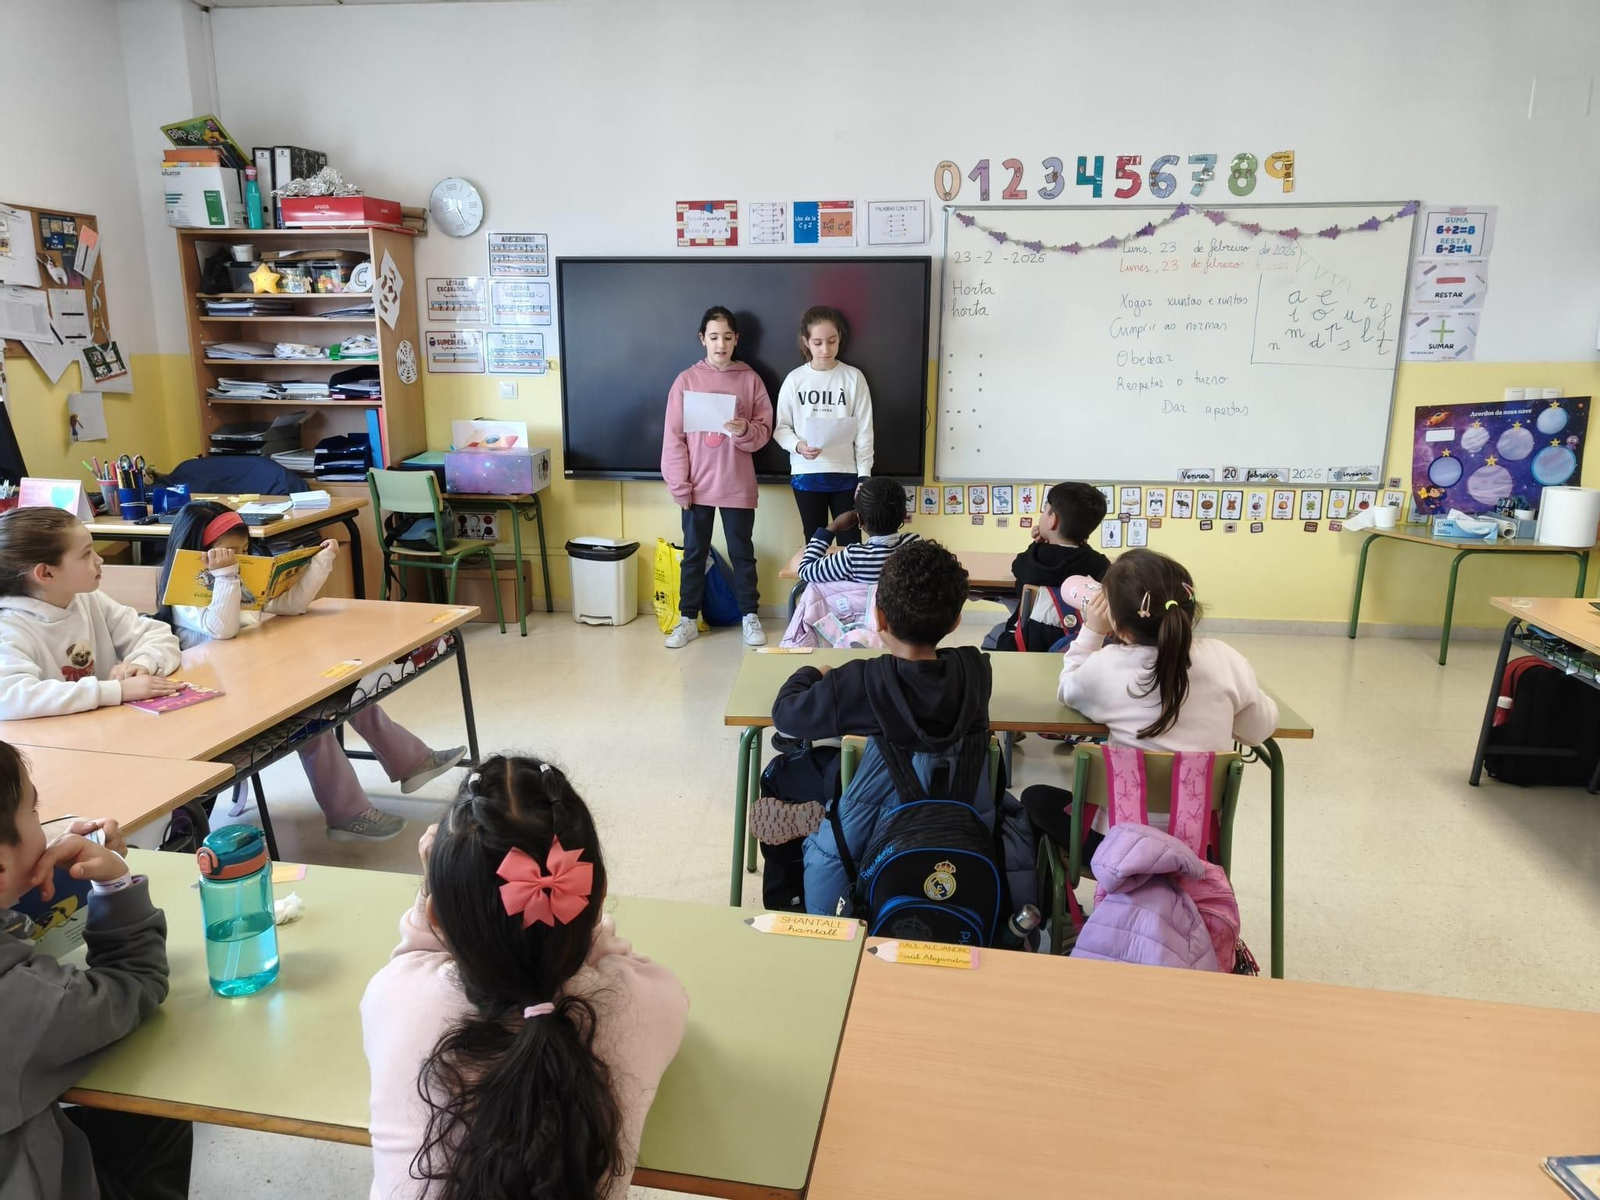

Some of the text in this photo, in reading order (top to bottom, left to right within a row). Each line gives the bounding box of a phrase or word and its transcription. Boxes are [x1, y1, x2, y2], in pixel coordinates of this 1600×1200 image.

[934, 150, 1295, 201] 0 1 2 3 4 5 6 7 8 9
[1436, 225, 1475, 235] 6+2=8
[1160, 242, 1177, 253] 23
[1194, 240, 1204, 253] de
[1435, 245, 1472, 253] 6-2=4
[1191, 259, 1201, 268] de
[952, 279, 995, 295] Horta
[1288, 289, 1338, 305] a e
[951, 297, 989, 317] horta
[1120, 293, 1152, 317] Xogar
[1311, 308, 1334, 321] o
[1344, 310, 1361, 323] u
[1110, 317, 1157, 339] Cumprir
[1186, 322, 1228, 331] normas
[1285, 328, 1305, 339] m
[1268, 342, 1280, 350] n
[1309, 333, 1325, 348] d
[1377, 330, 1393, 355] t
[1116, 377, 1163, 395] Respetar
[1194, 370, 1228, 385] turno
[798, 387, 846, 406] VOILÀ
[1162, 400, 1249, 421] Dar apertas
[1181, 470, 1210, 480] Venres
[1223, 469, 1237, 479] 20
[1246, 470, 1280, 481] febreiro
[1292, 468, 1322, 480] 2026
[781, 916, 844, 929] SHANTALL
[923, 944, 970, 954] ALEJANDRO
[923, 953, 970, 964] Alejandro
